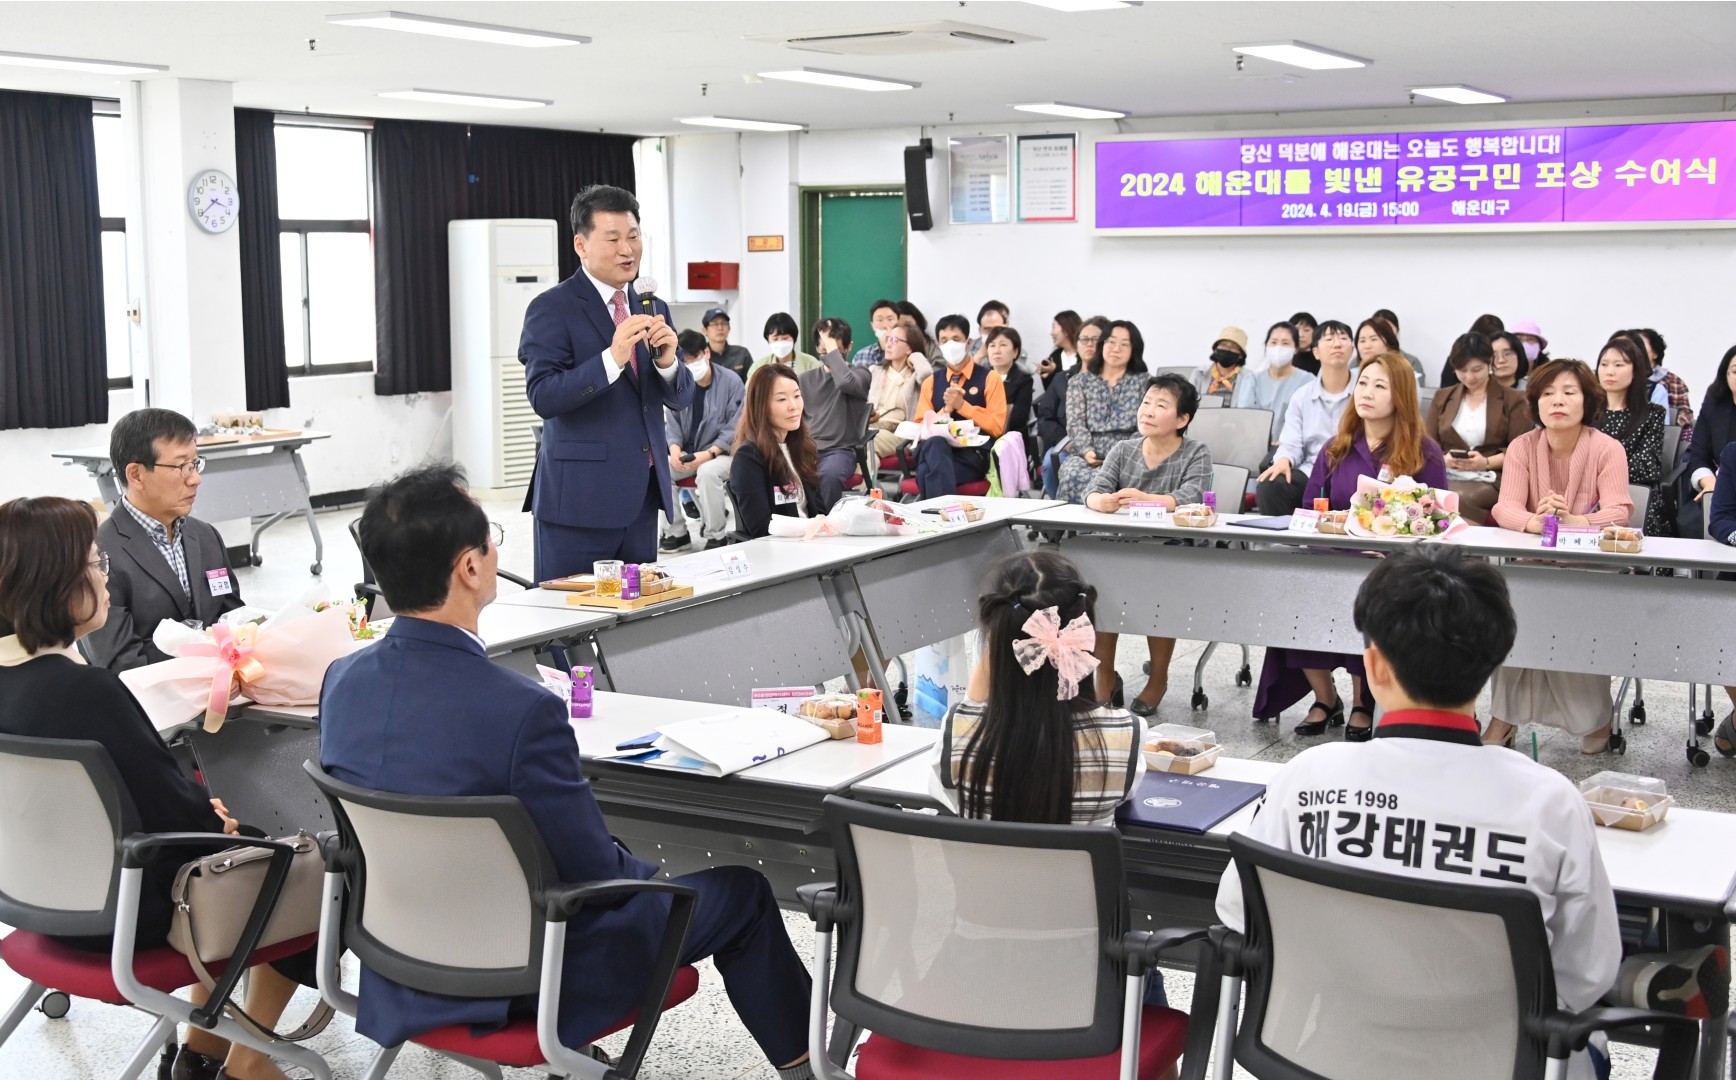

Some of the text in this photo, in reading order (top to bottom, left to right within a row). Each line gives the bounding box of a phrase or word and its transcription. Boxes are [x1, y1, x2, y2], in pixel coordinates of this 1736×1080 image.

[1240, 134, 1561, 164] 당신 덕분에 해운대는 오늘도 행복합니다!
[1120, 157, 1717, 197] 2024 해운대를 빛낸 유공구민 포상 수여식
[1381, 201, 1420, 217] 15:00
[1451, 199, 1510, 216] 해운대구
[1298, 789, 1399, 810] SINCE 1998
[1297, 810, 1527, 885] 해강태권도
